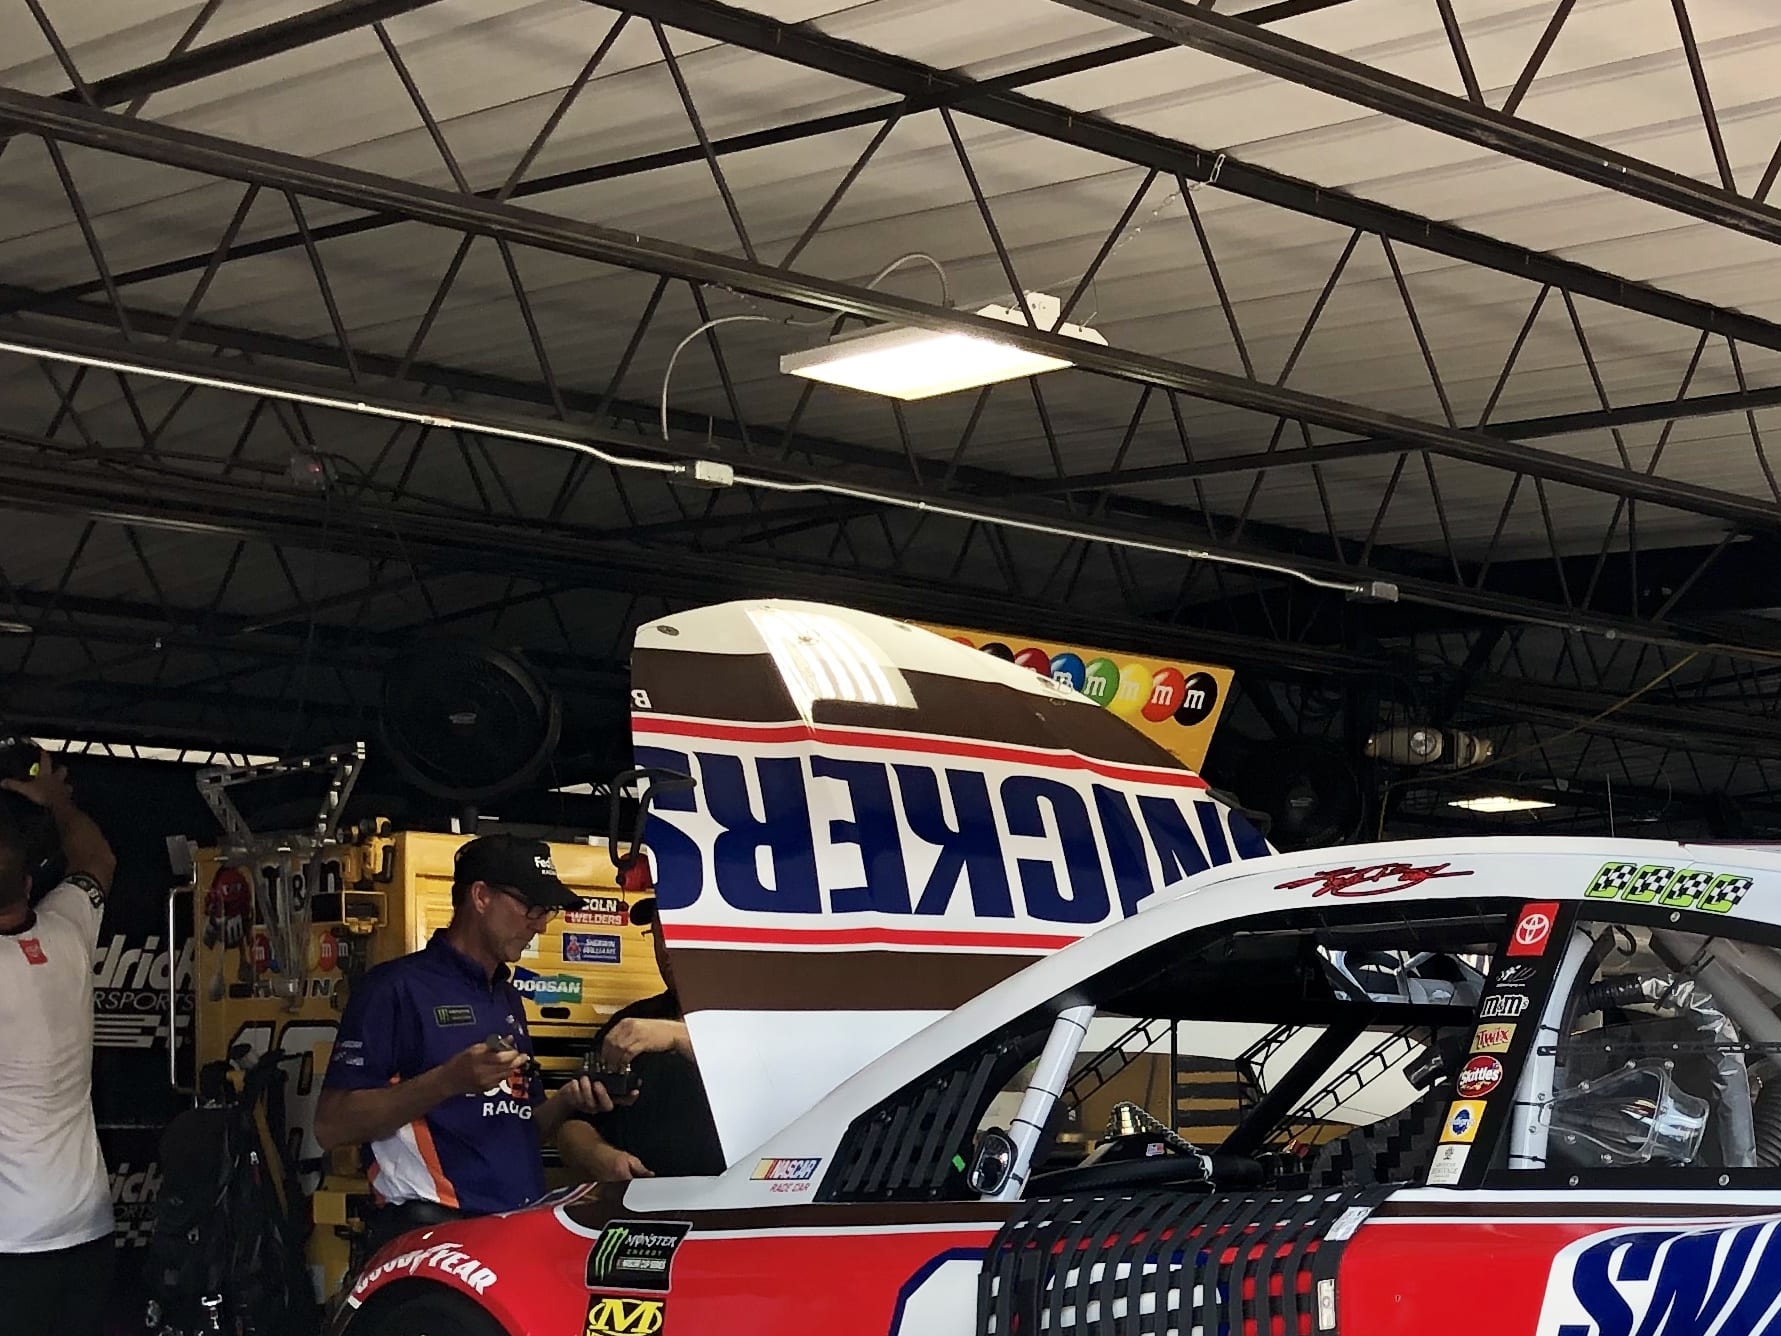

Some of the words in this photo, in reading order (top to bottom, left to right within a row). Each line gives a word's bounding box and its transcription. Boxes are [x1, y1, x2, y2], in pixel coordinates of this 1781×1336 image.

[633, 688, 651, 709] B
[571, 912, 622, 925] WELDERS
[95, 992, 194, 1011] RSPORTS
[1460, 1066, 1500, 1085] Skittles
[772, 1159, 818, 1180] NASCAR
[356, 1243, 498, 1296] GOODYEAR
